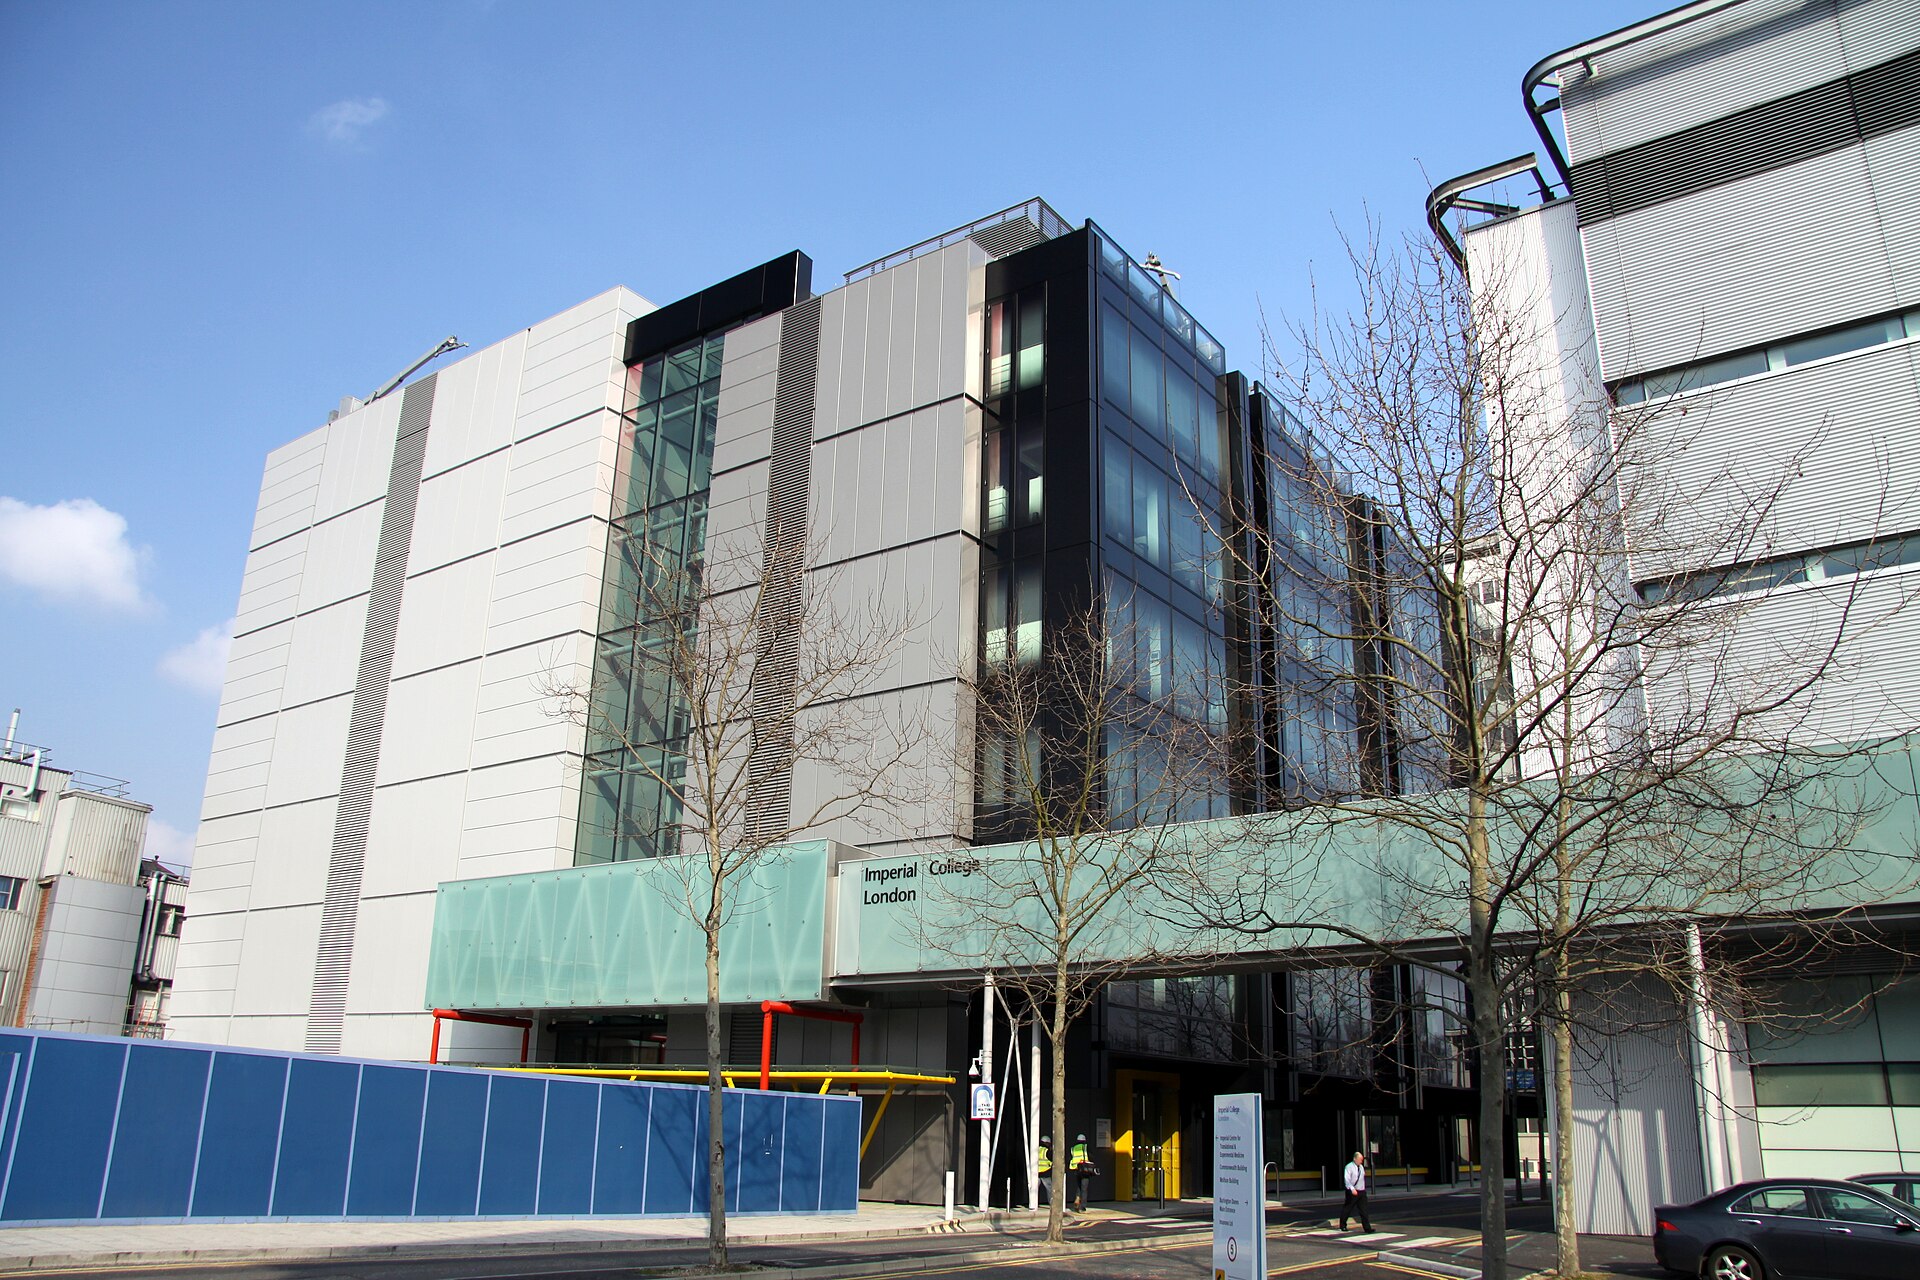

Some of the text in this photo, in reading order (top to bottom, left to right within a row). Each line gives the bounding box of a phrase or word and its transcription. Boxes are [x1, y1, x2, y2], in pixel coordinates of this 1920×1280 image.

[865, 858, 980, 885] Imperial College
[864, 887, 916, 905] London
[1218, 1105, 1240, 1115] Imperial College
